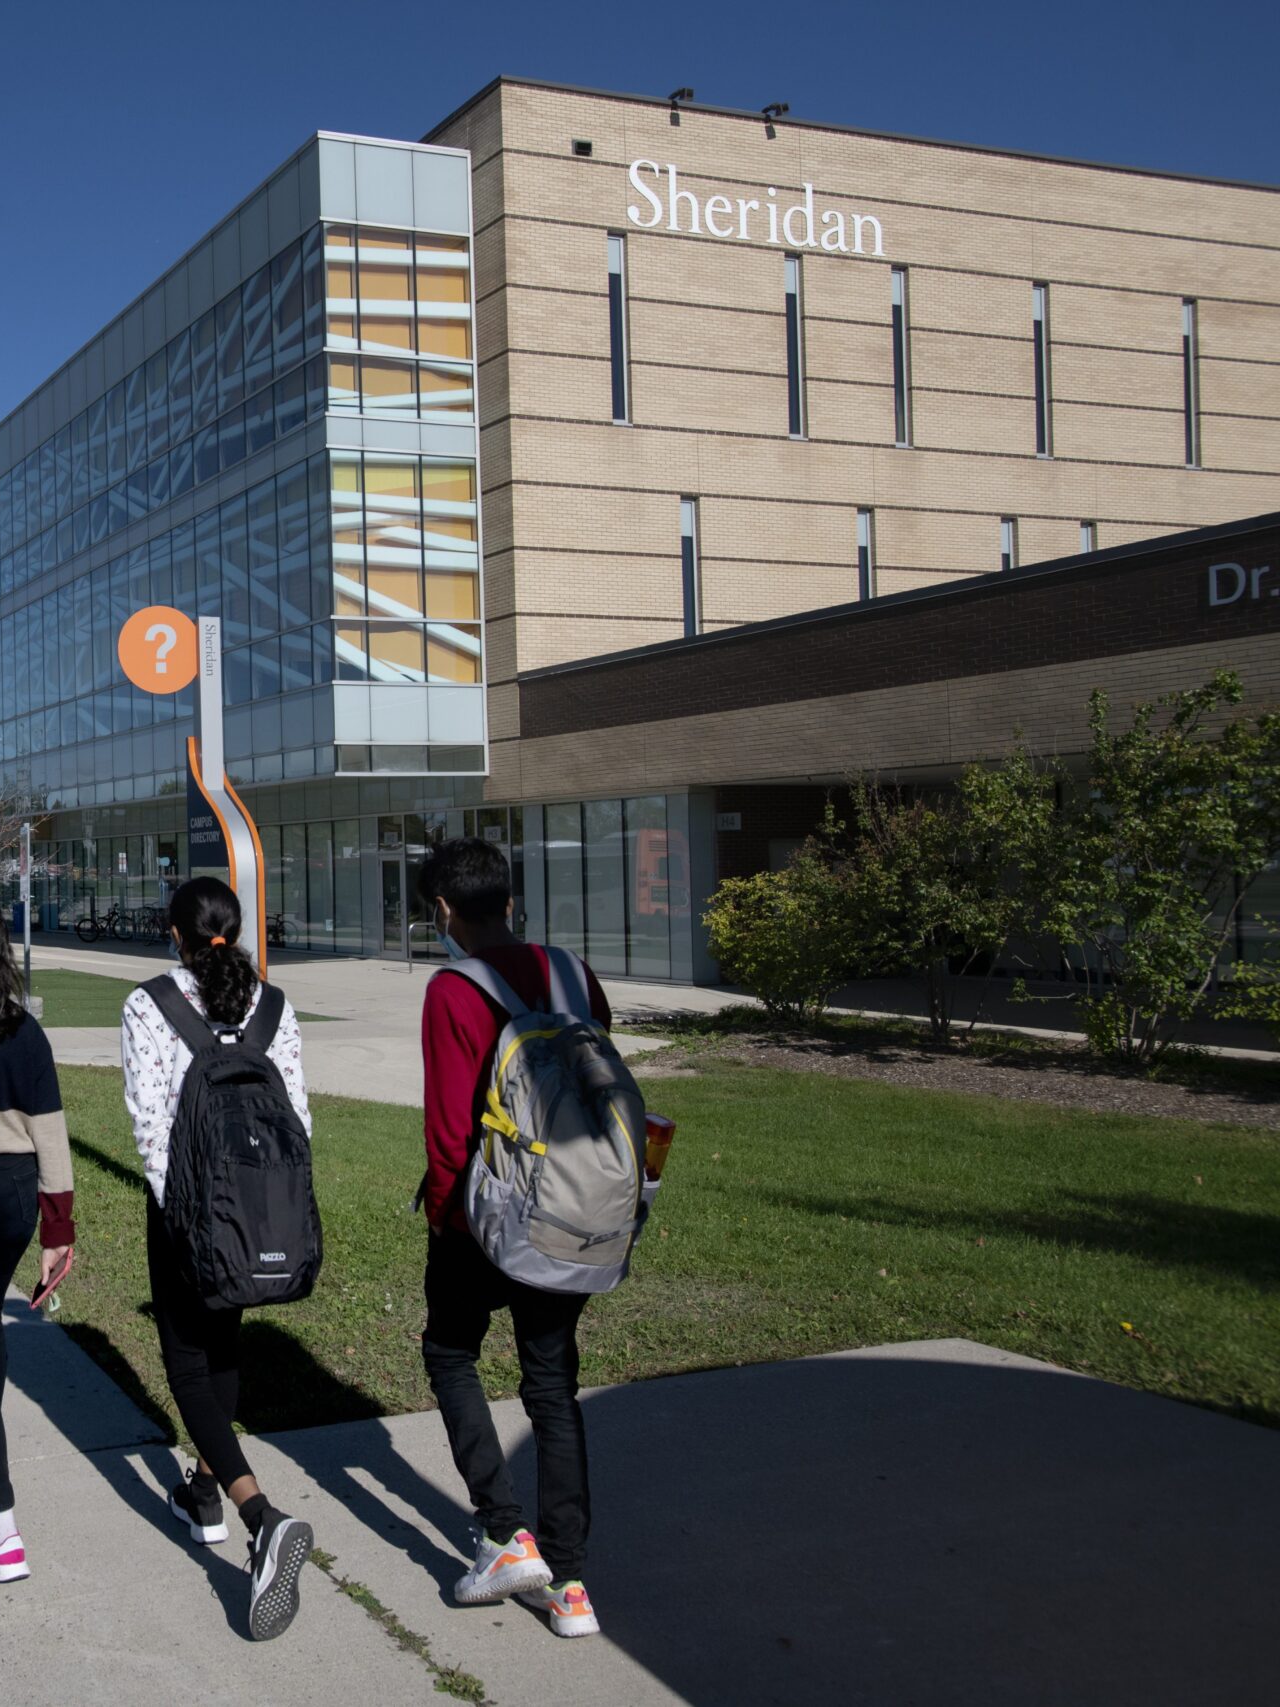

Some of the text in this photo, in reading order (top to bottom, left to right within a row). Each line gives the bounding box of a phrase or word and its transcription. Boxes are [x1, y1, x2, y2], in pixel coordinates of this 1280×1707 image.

[627, 158, 886, 258] Sheridan
[1208, 562, 1280, 606] Dr.
[144, 623, 177, 674] ?
[205, 624, 216, 677] Sheridan
[190, 816, 213, 829] CAMPUS
[190, 831, 220, 844] DIRECTORY
